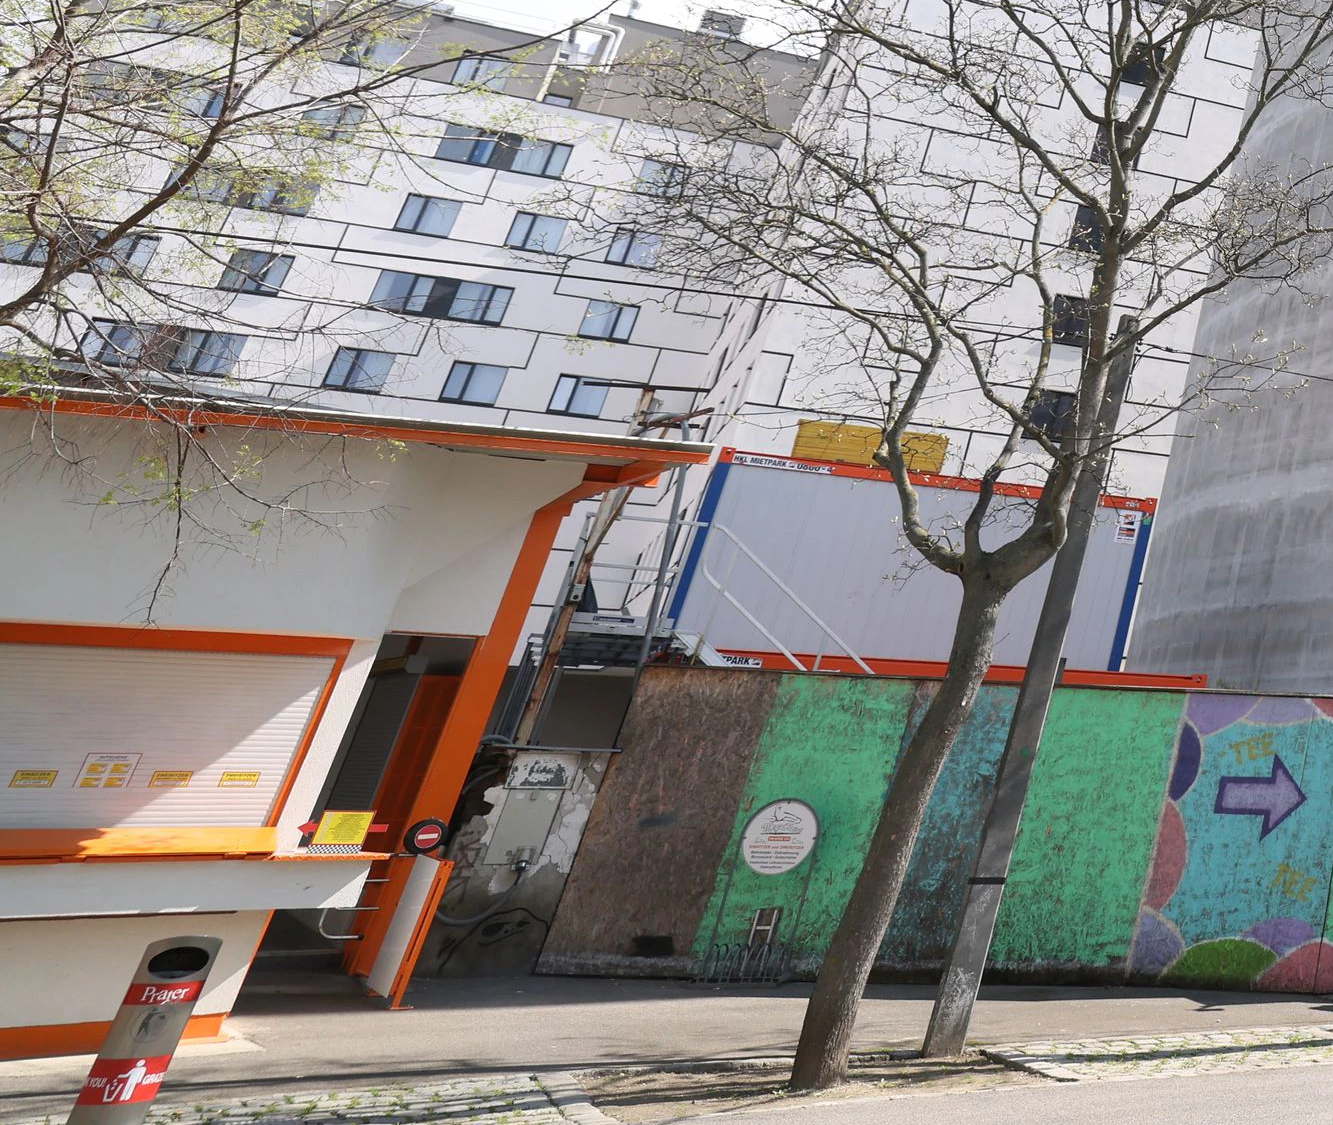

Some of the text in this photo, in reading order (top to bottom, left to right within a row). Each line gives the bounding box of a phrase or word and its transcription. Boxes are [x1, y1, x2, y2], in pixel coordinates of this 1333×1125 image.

[734, 455, 748, 463] HKL
[750, 457, 787, 467] MIETPARK
[722, 655, 750, 665] PARK
[1231, 732, 1278, 765] TEE
[89, 1077, 107, 1088] YOU!
